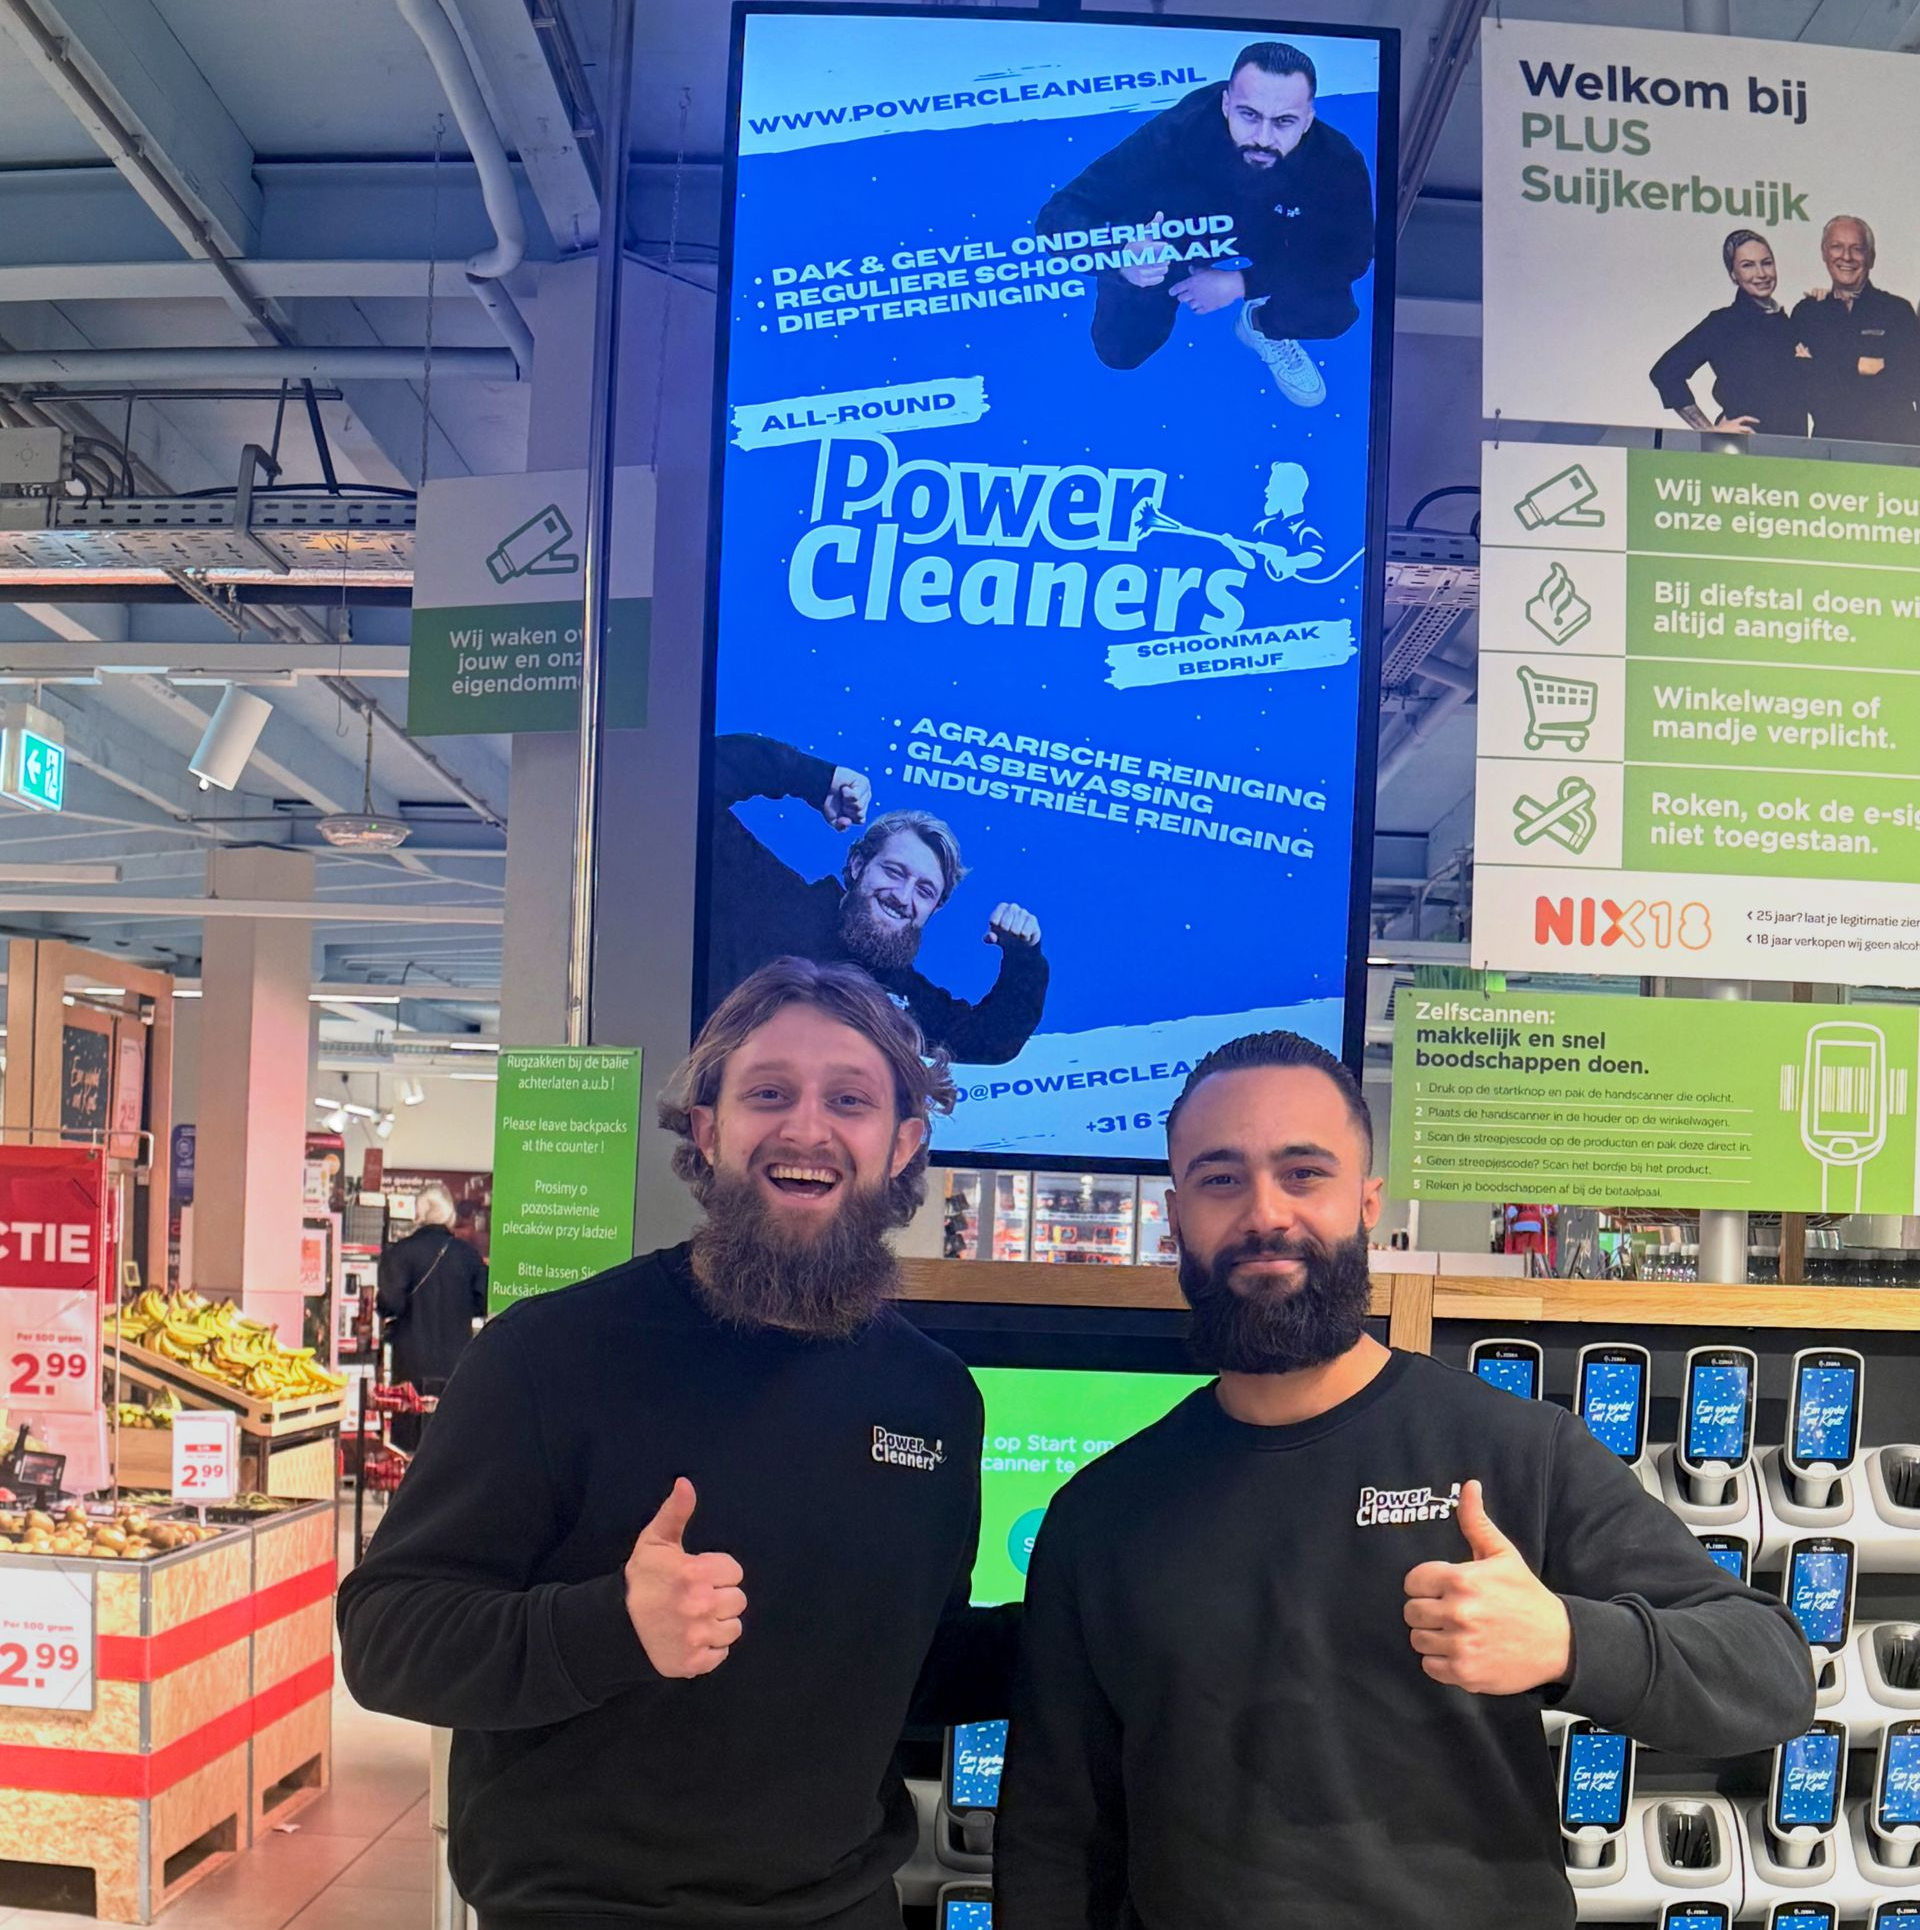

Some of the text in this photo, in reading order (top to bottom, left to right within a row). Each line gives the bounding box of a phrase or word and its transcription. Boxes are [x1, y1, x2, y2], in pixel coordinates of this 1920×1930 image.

[748, 66, 1208, 136] WWW.POWERCLEANERS.NL
[1518, 60, 1808, 125] Welkom bij
[1521, 112, 1652, 157] PLUS
[1521, 165, 1811, 227] Suijkerbuijk
[772, 214, 1234, 287] DAK & GEVEL ONDERHOUD
[774, 237, 1240, 311] REGULIERE SCHOONMAAK
[778, 279, 1087, 335] DIEPTEREINIGING
[761, 393, 957, 433] ALL-ROUND
[810, 432, 1167, 551] Power
[1654, 478, 1702, 507] Wij
[1710, 483, 1800, 509] waken
[1808, 492, 1870, 513] over
[1653, 508, 1722, 532] onze
[789, 523, 1248, 635] Cleaners
[1654, 580, 1882, 617] Bij diefstal doen
[450, 627, 557, 650] Wij waken
[1653, 611, 1857, 645] altijd aangifte.
[1137, 626, 1321, 658] SCHOONMAAK
[457, 653, 540, 674] jouw en
[1178, 653, 1284, 677] BEDRIJF
[1653, 685, 1881, 721] Winkelwagen of
[1652, 719, 1897, 750] mandje verplicht.
[911, 717, 1327, 811] AGRARISCHE REINIGING
[907, 741, 1214, 814] GLASBEWASSING
[903, 764, 1315, 859] INDUSTRIËLE REINIGING
[1651, 791, 1854, 824] Roken, ook de
[1650, 823, 1879, 855] niet toegestaan.
[1534, 895, 1713, 951] NIX18
[1756, 910, 1899, 928] 25 jaar? laat je legitimatie
[1756, 933, 1891, 952] 18 jaar verkopen wij geen
[1415, 1001, 1555, 1025] Zelfscannen:
[1416, 1026, 1606, 1050] makkelijk en snel
[507, 1055, 629, 1072] Rugzakken bij de balie
[1416, 1048, 1650, 1075] boodschappen doen.
[518, 1076, 609, 1090] achterlaten a.u.b
[1429, 1082, 1735, 1103] Druk op de startknop en pak de handscanner die oplicht.
[503, 1116, 628, 1134] Please leave backpacks
[1133, 1112, 1152, 1129] 6
[1428, 1106, 1730, 1128] Plaats de handscanner in de houder op de winkelwagen.
[522, 1138, 599, 1153] at the counter
[1427, 1131, 1736, 1151] Scan de streepjescode op de producten en pak deze direct
[1426, 1155, 1712, 1175] Geen streepjescode? Scan het bordje bij het product.
[535, 1180, 588, 1197] Prosimy o
[1426, 1180, 1459, 1191] Reken
[1462, 1180, 1472, 1192] je
[1475, 1181, 1556, 1194] boodschappen
[1558, 1182, 1569, 1193] af
[1572, 1184, 1585, 1196] bij
[1588, 1186, 1602, 1196] de
[521, 1202, 600, 1218] pozostawienie
[503, 1221, 617, 1240] plecaków przy ladzie!
[518, 1262, 578, 1279] Bitte lassen
[10, 1353, 87, 1395] 2.99
[873, 1425, 925, 1453] Power
[994, 1436, 1021, 1453] op
[1027, 1435, 1078, 1453] Start
[871, 1443, 935, 1471] Cleaners
[1056, 1456, 1077, 1473] te
[181, 1464, 224, 1487] 2.99
[1359, 1486, 1432, 1508] Power
[1356, 1503, 1451, 1527] Cleaners
[0, 1642, 79, 1689] 2.99
